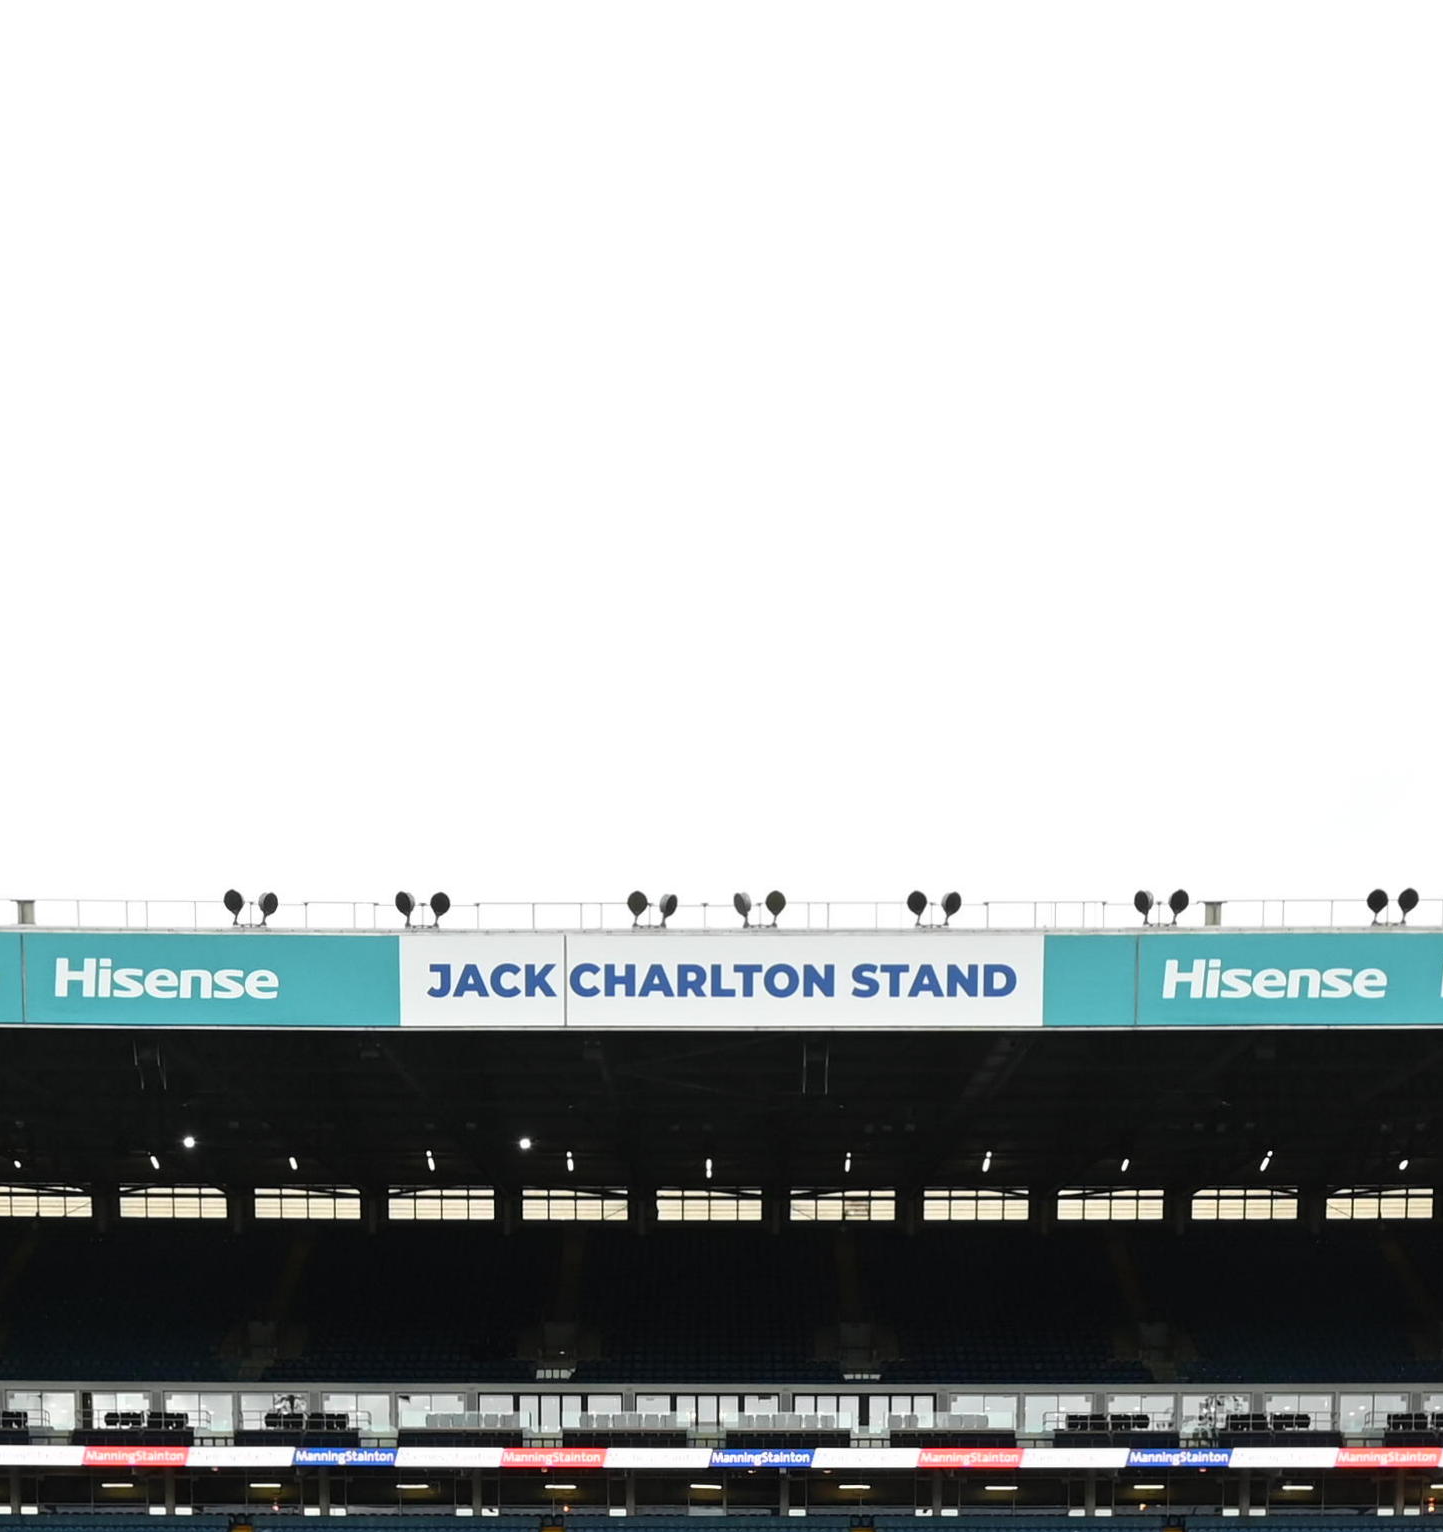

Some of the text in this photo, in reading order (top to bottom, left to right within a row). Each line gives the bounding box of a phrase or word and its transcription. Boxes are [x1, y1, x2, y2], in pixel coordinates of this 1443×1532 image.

[55, 957, 279, 999] Hisense
[427, 962, 1018, 999] JACK CHARLTON STAND
[1161, 958, 1387, 1000] Hisense
